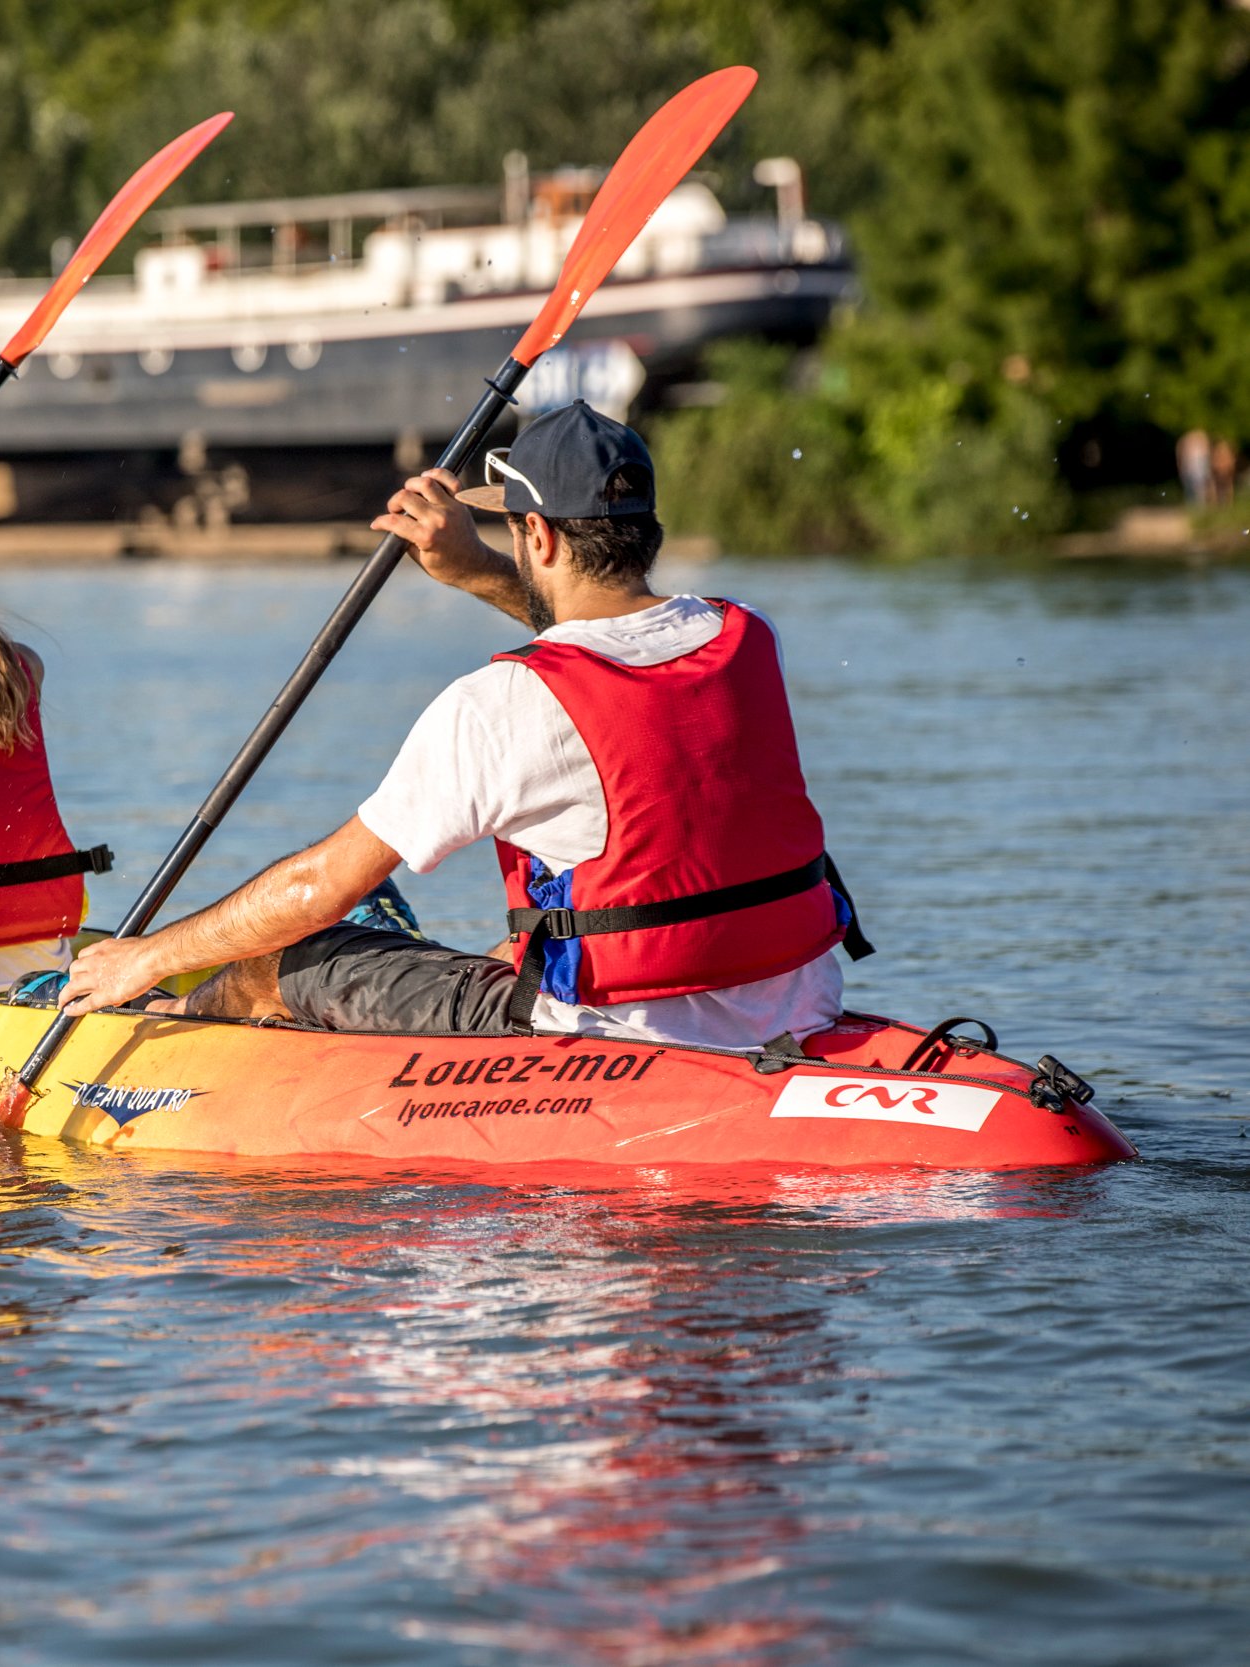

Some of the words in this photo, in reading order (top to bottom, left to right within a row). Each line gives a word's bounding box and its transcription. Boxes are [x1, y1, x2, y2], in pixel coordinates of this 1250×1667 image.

[388, 1049, 667, 1088] Louez-moi
[71, 1083, 130, 1108] OCEAN
[127, 1085, 192, 1112] QUATRO
[397, 1095, 593, 1127] lyoncanoe.com
[824, 1084, 939, 1115] CNR
